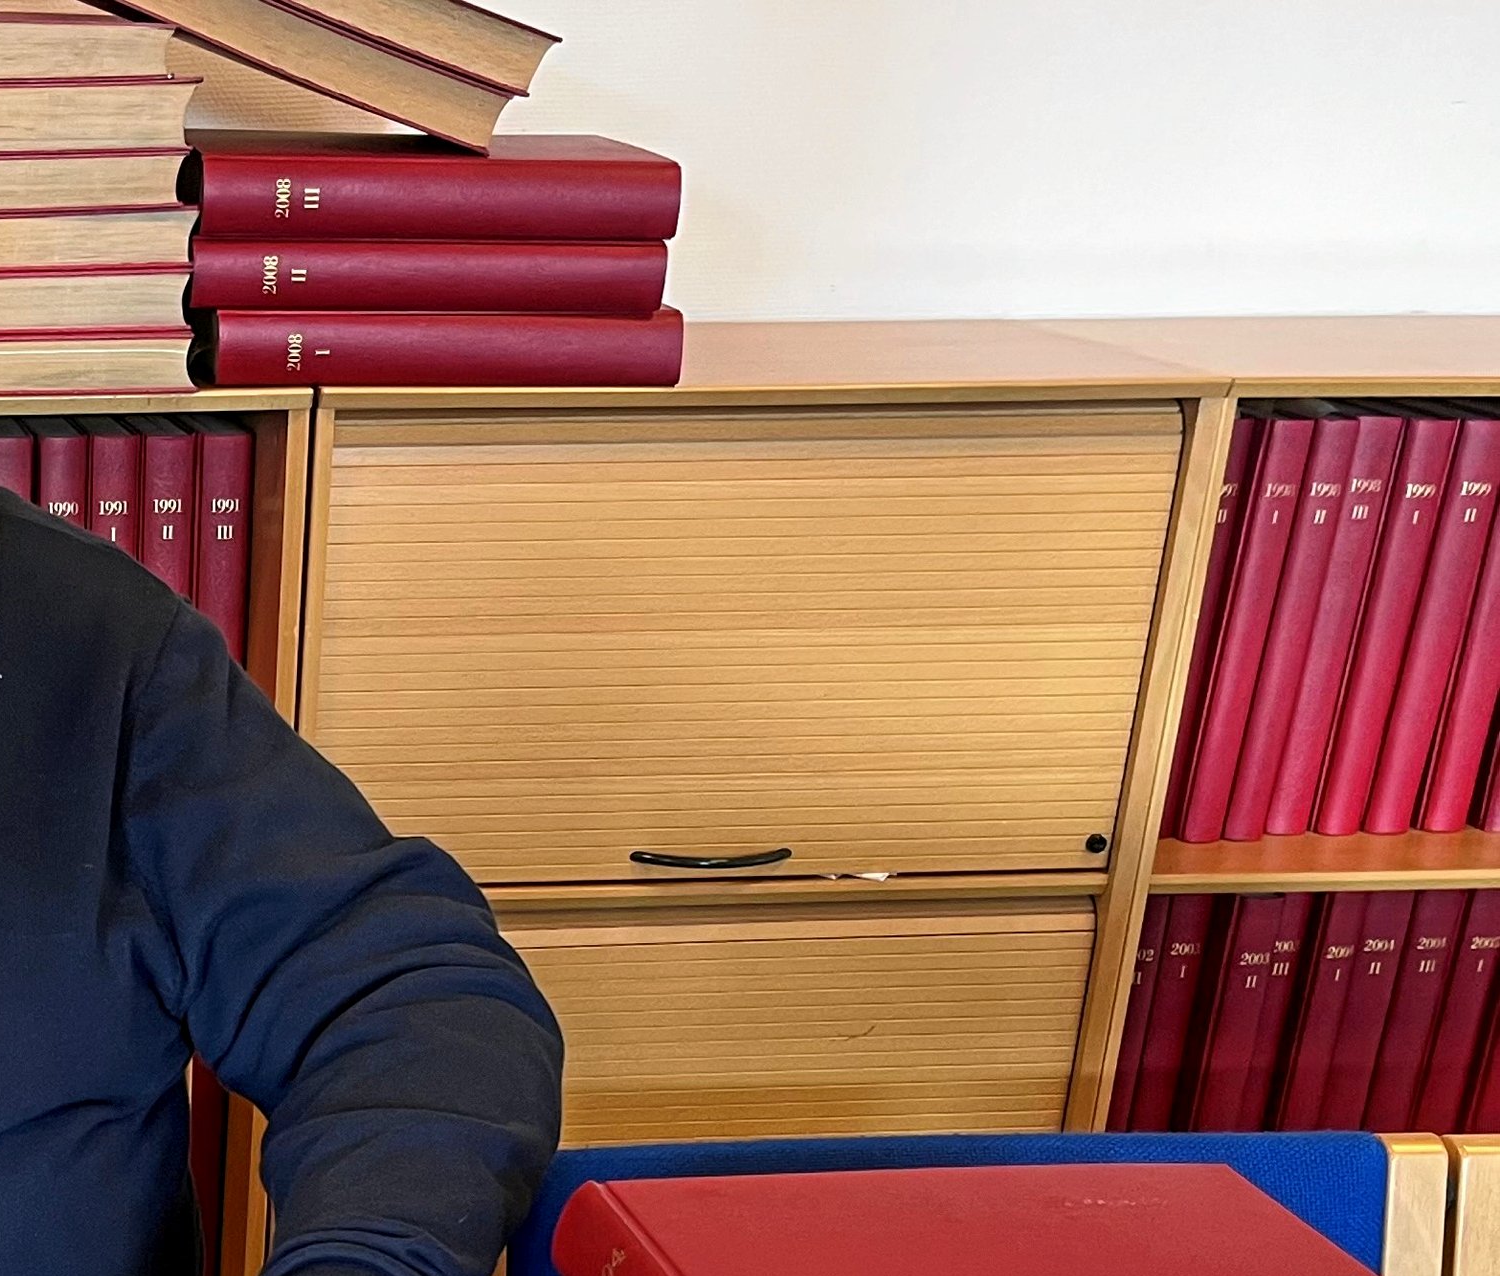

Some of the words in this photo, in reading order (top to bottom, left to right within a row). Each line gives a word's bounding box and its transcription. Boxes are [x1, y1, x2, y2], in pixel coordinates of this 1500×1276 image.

[274, 177, 292, 219] 2008
[303, 187, 321, 209] III
[262, 255, 279, 295] 2008
[291, 268, 307, 282] II
[287, 333, 304, 372] 2008
[315, 348, 331, 356] I
[1350, 478, 1382, 493] 1998
[1405, 483, 1436, 499] 1999
[1460, 481, 1492, 496] 1999
[48, 501, 79, 516] 1990
[99, 500, 128, 516] 1991
[153, 499, 182, 514] 1991
[211, 498, 239, 513] 1991
[1351, 505, 1369, 520] III
[1271, 510, 1279, 524] I
[1313, 509, 1326, 524] II
[1412, 510, 1420, 524] I
[1464, 508, 1477, 523] II
[162, 525, 174, 540] II
[216, 525, 233, 540] III
[1272, 962, 1289, 976] III
[1368, 962, 1381, 974] II
[1419, 959, 1436, 973] III
[1245, 975, 1257, 988] II
